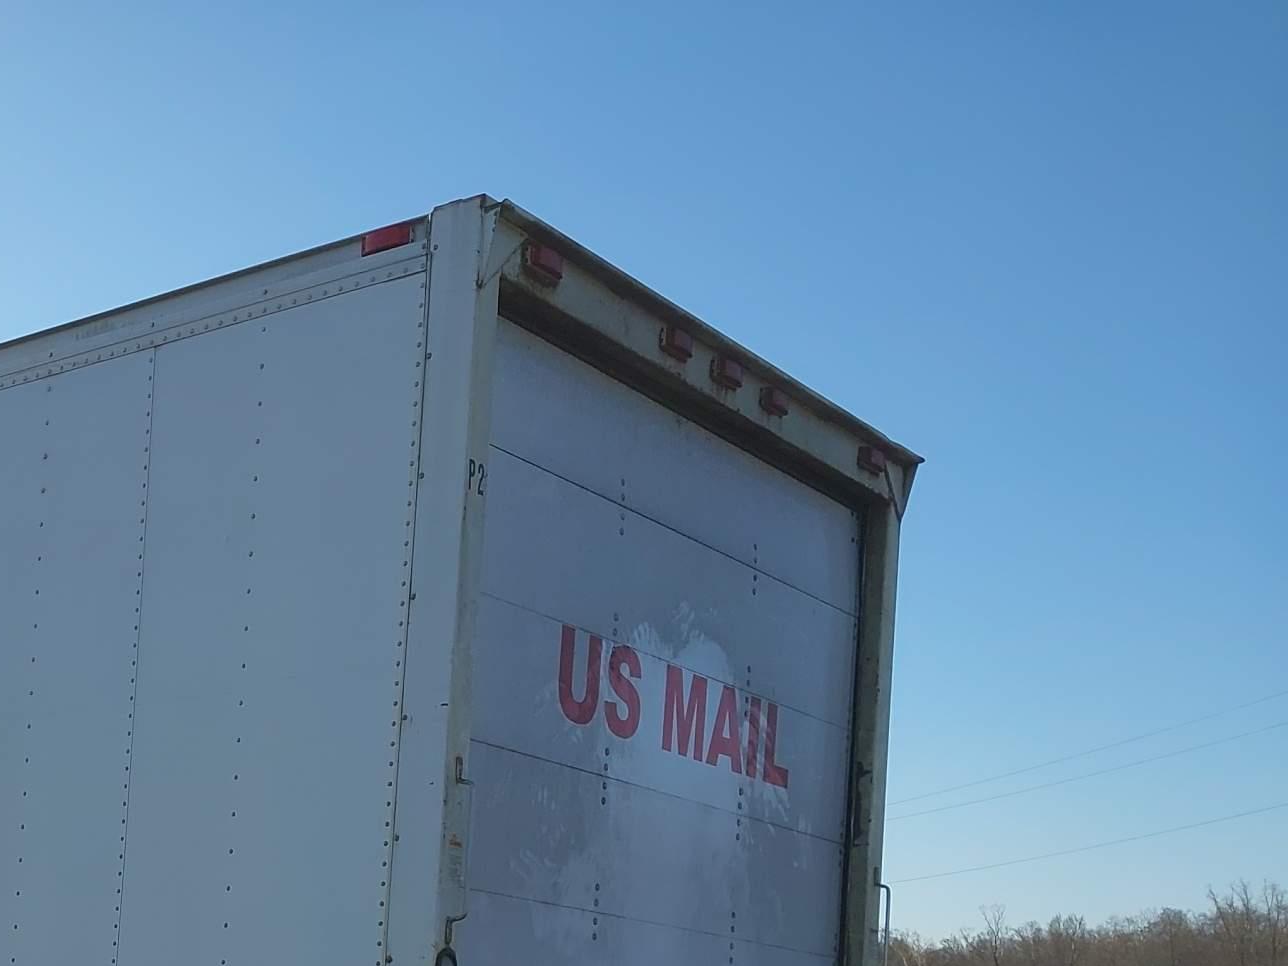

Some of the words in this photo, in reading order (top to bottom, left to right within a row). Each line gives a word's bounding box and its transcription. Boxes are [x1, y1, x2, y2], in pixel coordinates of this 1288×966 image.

[468, 458, 485, 496] P2
[558, 624, 642, 740] US
[661, 664, 789, 789] MAIL
